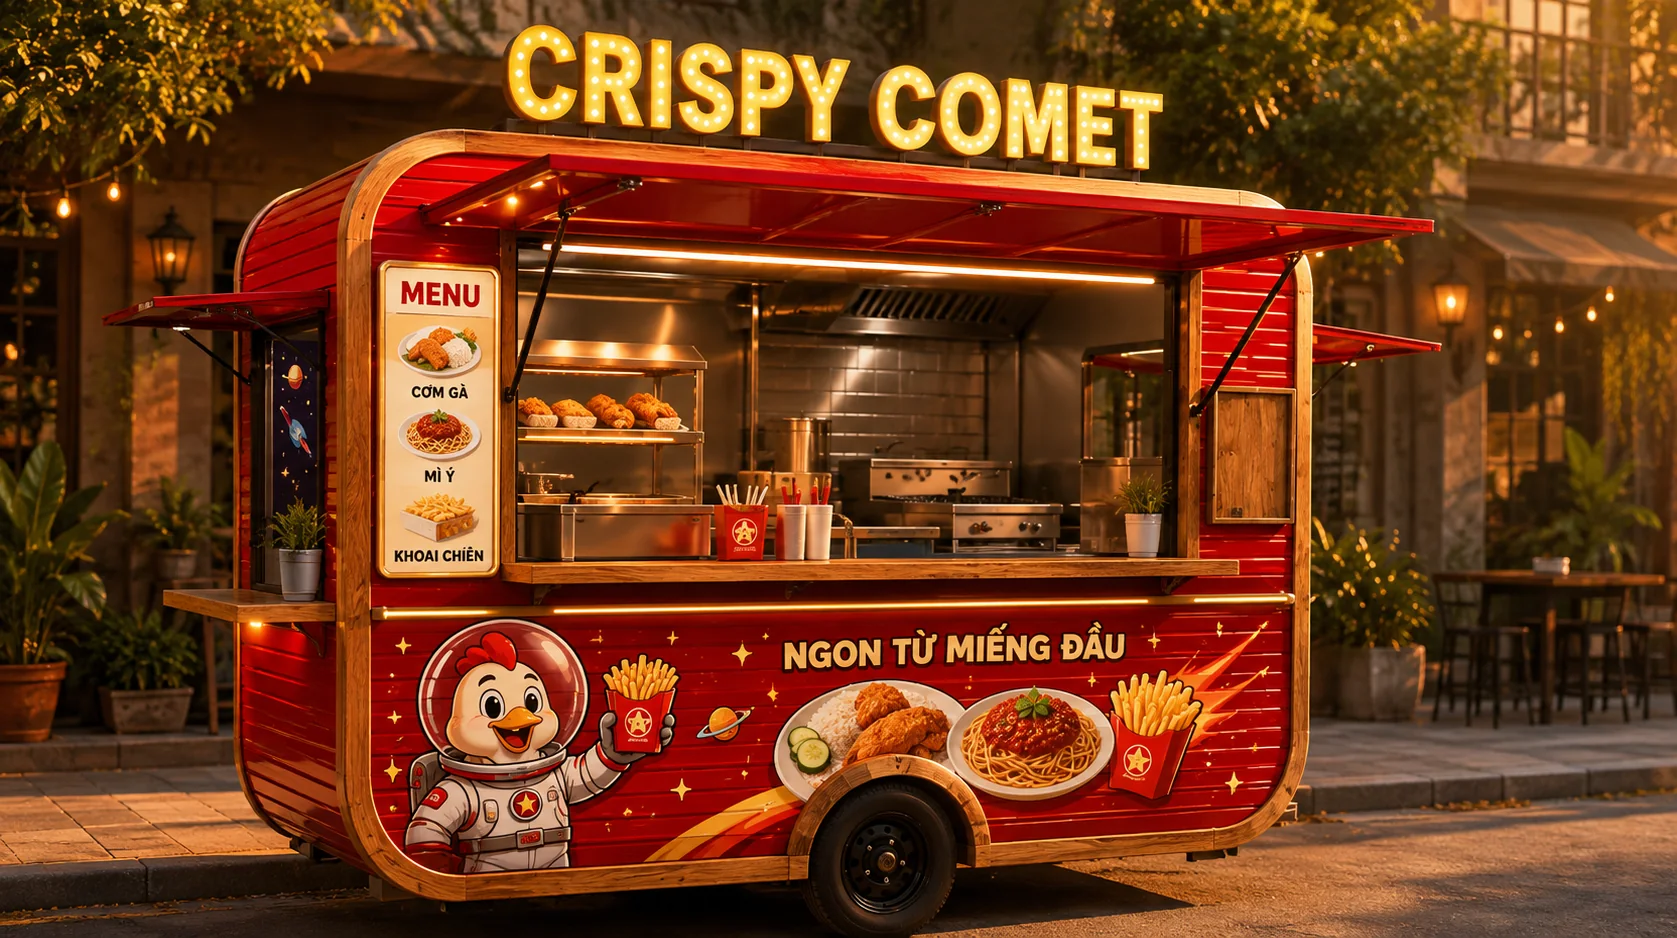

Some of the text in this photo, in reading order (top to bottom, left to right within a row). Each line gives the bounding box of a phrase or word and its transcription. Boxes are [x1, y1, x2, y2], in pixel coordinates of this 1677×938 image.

[504, 24, 1164, 170] CRISPY COMET
[401, 281, 480, 308] MENU
[448, 383, 469, 399] GÀ
[424, 466, 456, 483] MÌ Ý
[394, 549, 439, 562] KHOAI
[783, 621, 1126, 670] NGON TỪ MIẾNG ĐẦU
